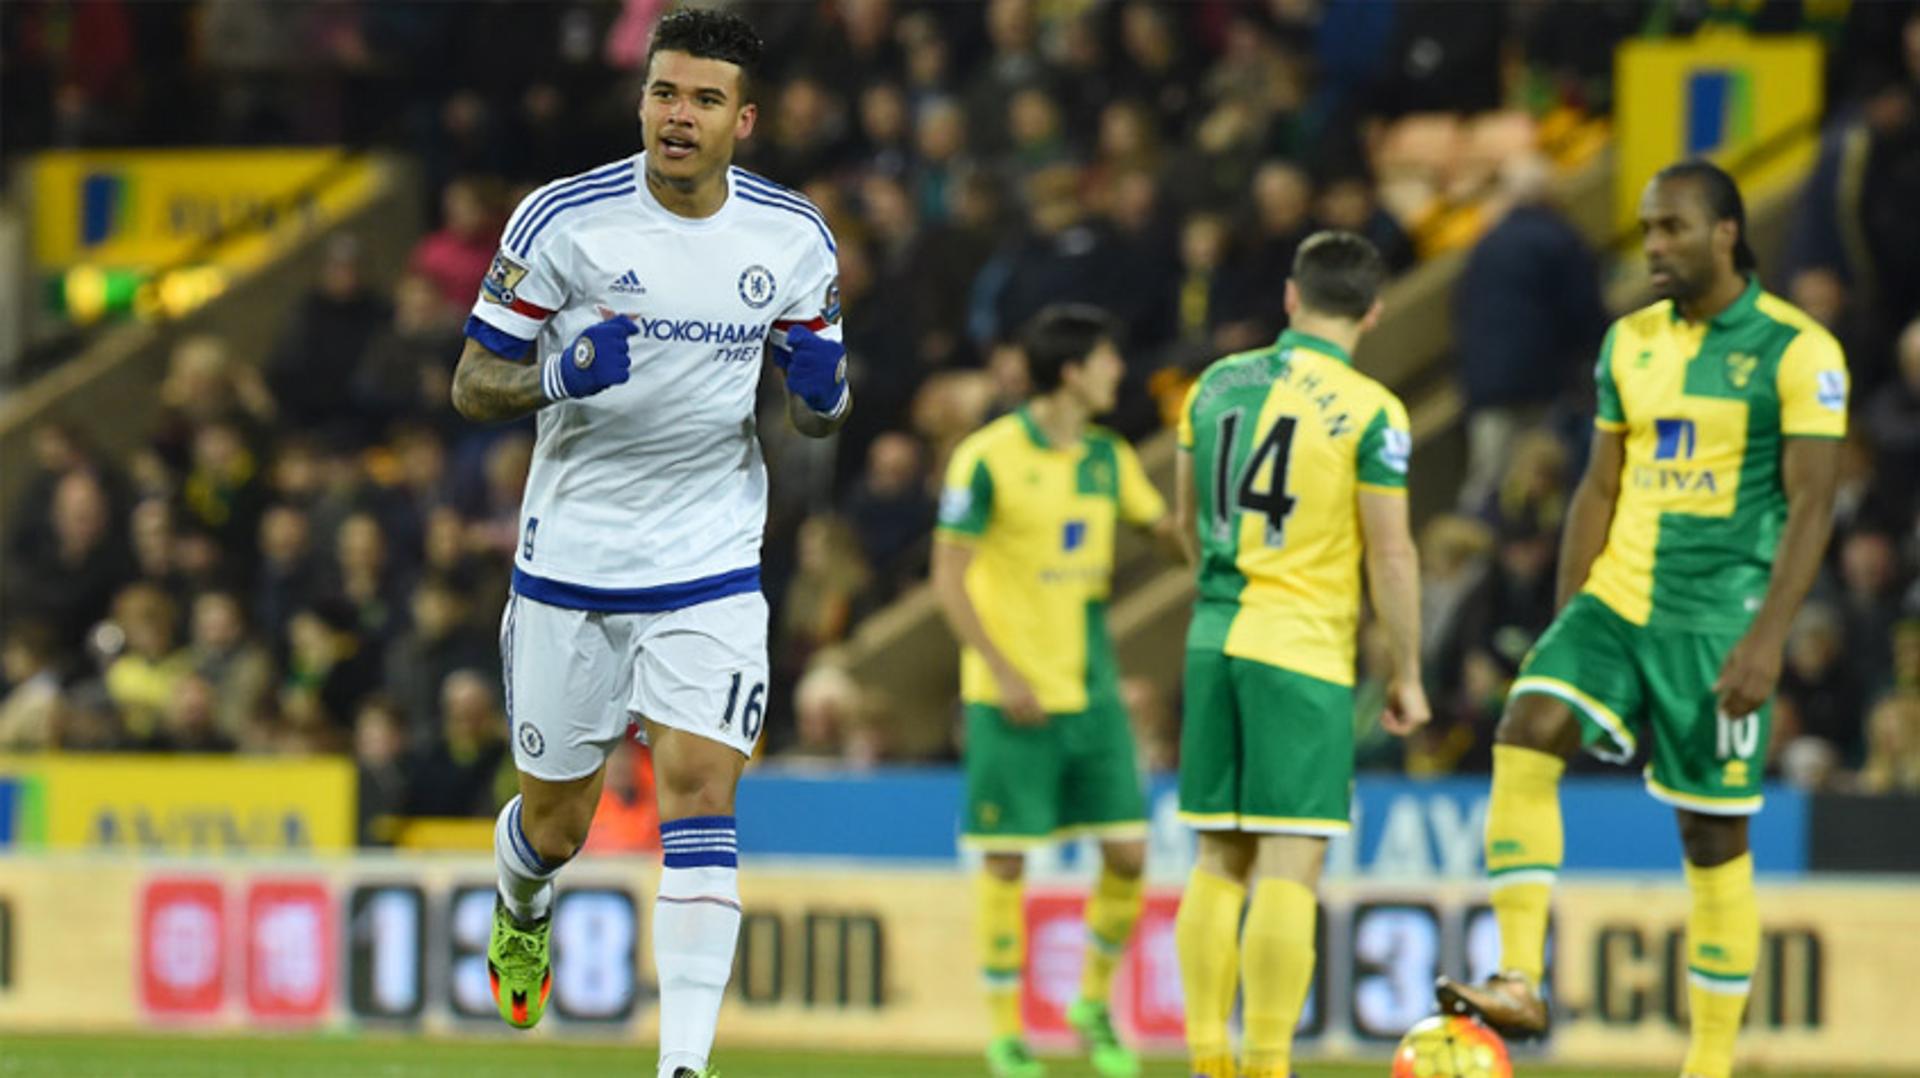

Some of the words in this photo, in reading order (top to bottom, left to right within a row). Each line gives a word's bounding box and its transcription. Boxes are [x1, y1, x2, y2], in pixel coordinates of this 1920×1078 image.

[641, 317, 766, 343] YOKOHAMA
[1214, 410, 1299, 545] 14
[720, 671, 765, 742] 16
[1716, 708, 1760, 759] 10
